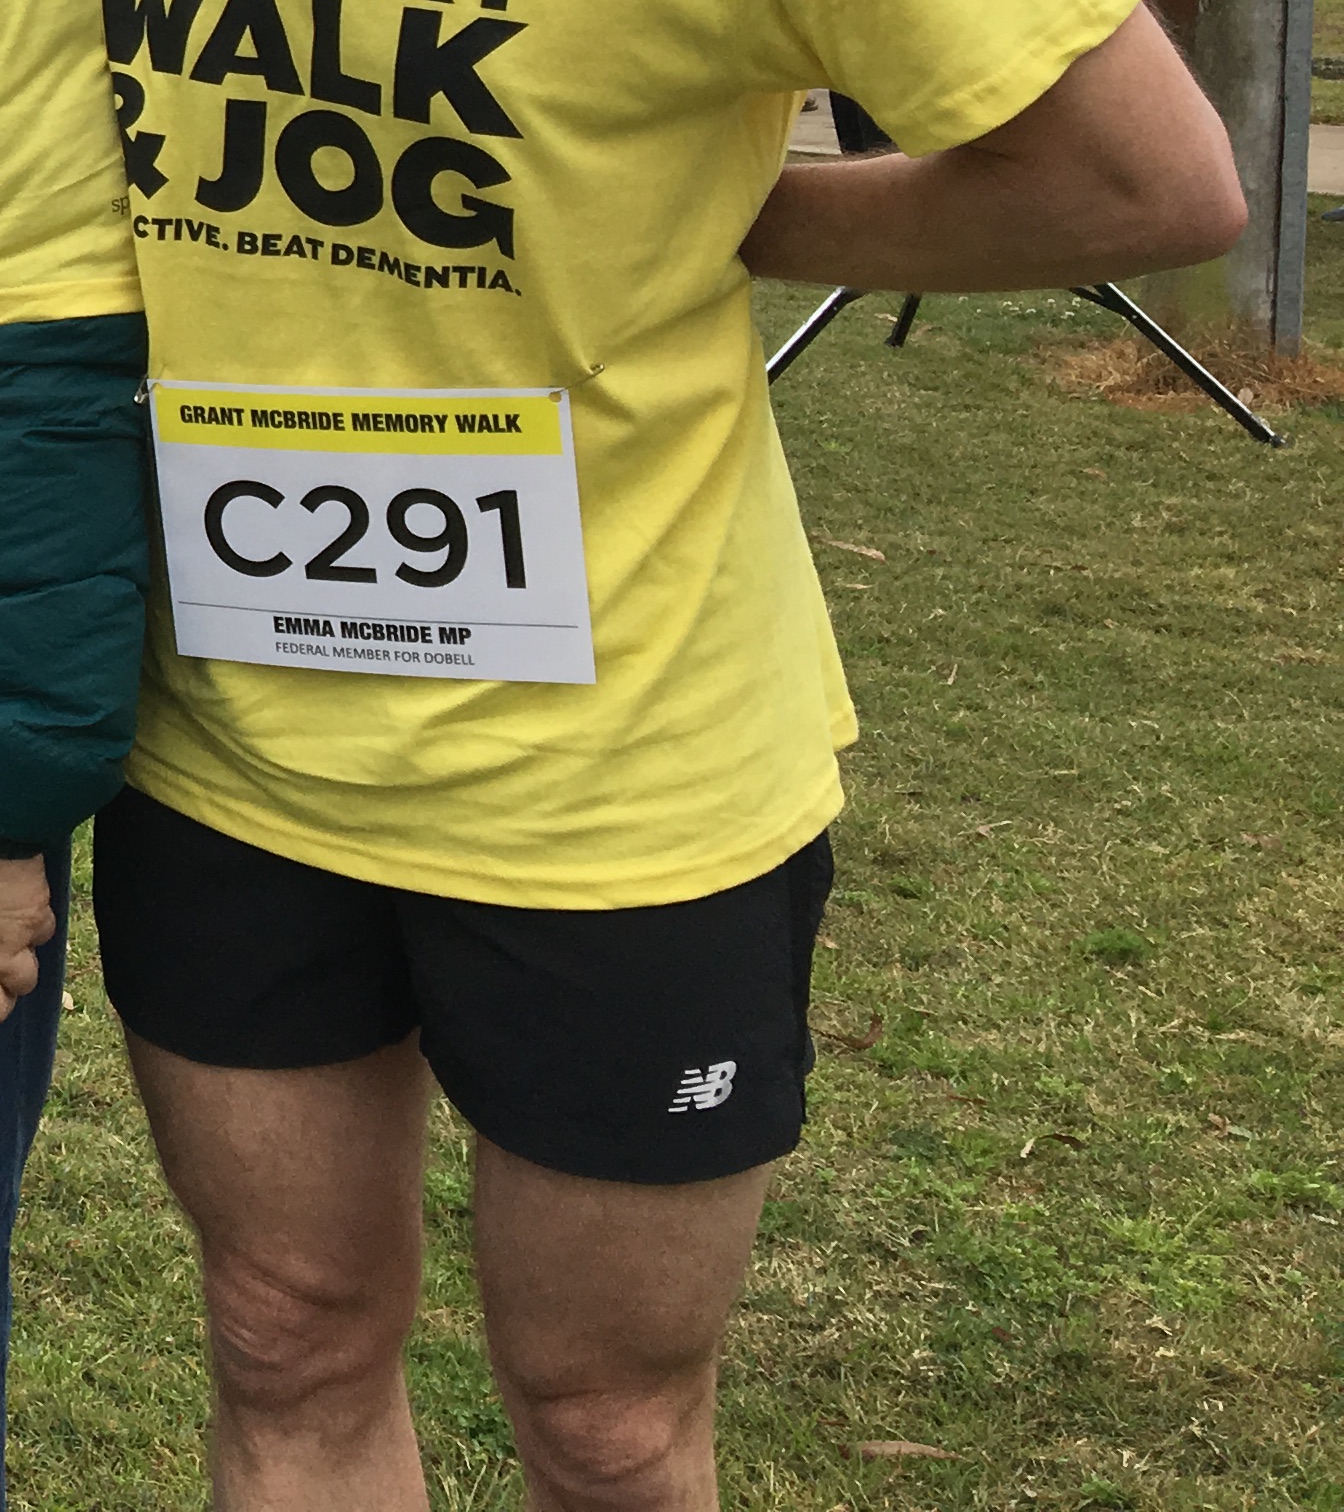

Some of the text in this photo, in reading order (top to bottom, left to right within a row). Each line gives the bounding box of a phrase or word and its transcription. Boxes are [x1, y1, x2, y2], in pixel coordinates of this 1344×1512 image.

[194, 97, 516, 261] JOG
[133, 214, 522, 297] CTIVE. BEAT DEMENTIA.
[179, 404, 523, 435] GRANT MCBRIDE MEMORY WALK
[203, 479, 528, 590] C291
[272, 615, 473, 647] EMMA MCBRIDE MP
[275, 641, 476, 667] FEDERAL MEMBER FOR DOBELL
